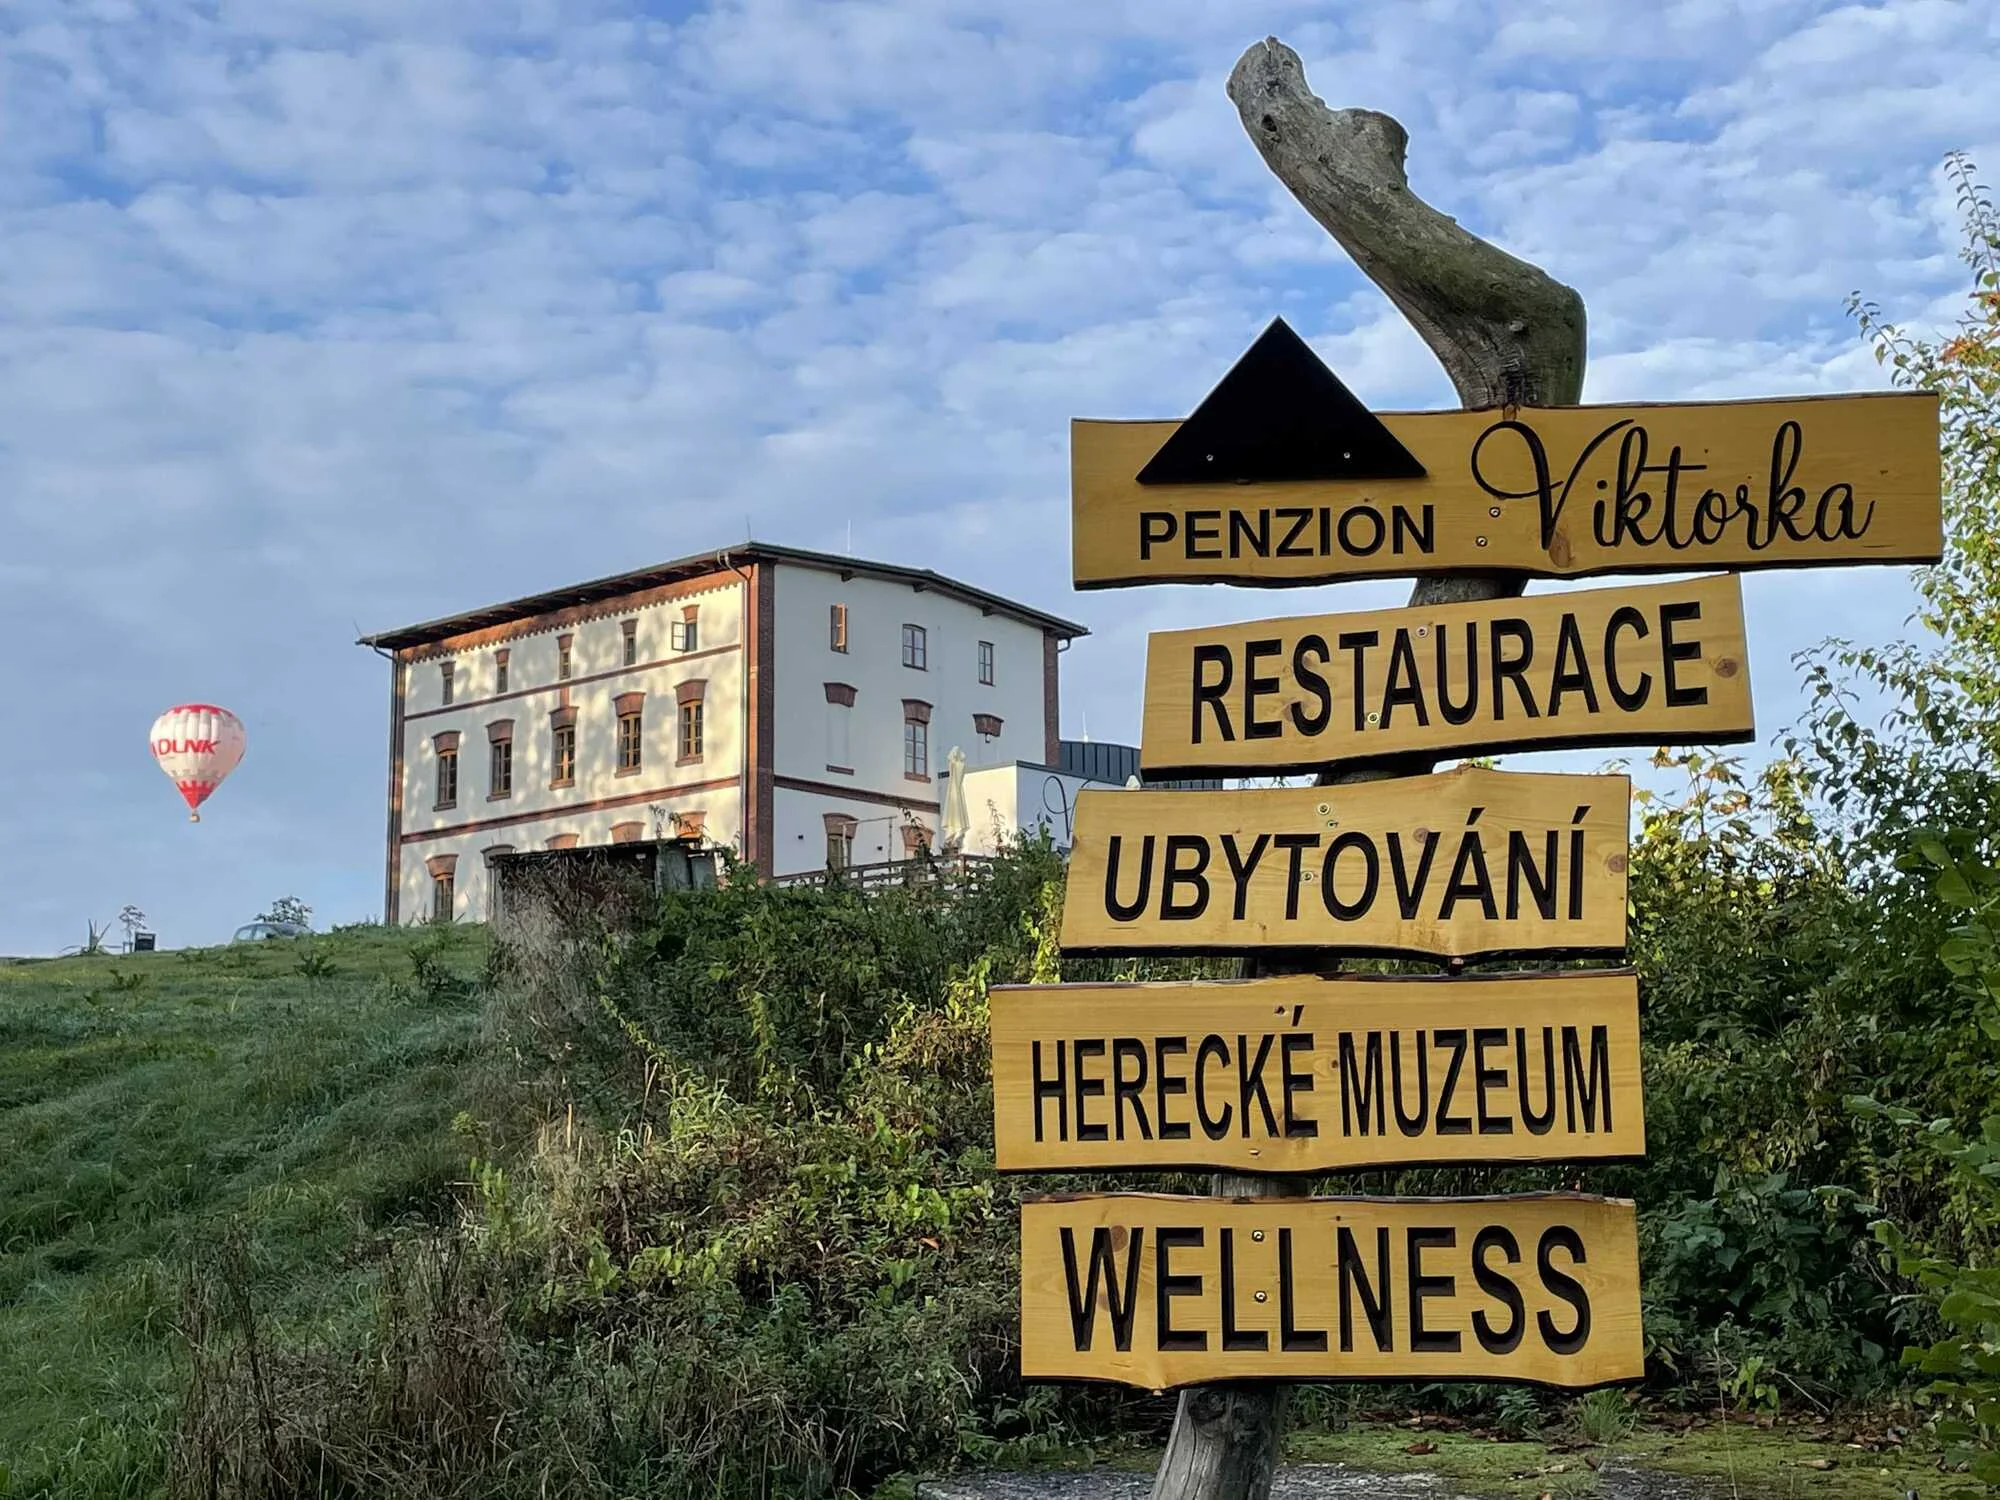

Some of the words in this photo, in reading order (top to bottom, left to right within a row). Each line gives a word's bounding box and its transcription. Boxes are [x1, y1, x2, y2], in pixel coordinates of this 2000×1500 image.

[1140, 505, 1433, 560] PENZION
[1472, 419, 1875, 550] Viktorka
[1191, 601, 1707, 744] RESTAURACE
[1105, 806, 1590, 921] UBYTOVÁNÍ
[1033, 1005, 1317, 1141] HERECKÉ
[1339, 1026, 1612, 1137] MUZEUM
[1060, 1226, 1590, 1354] WELLNESS
